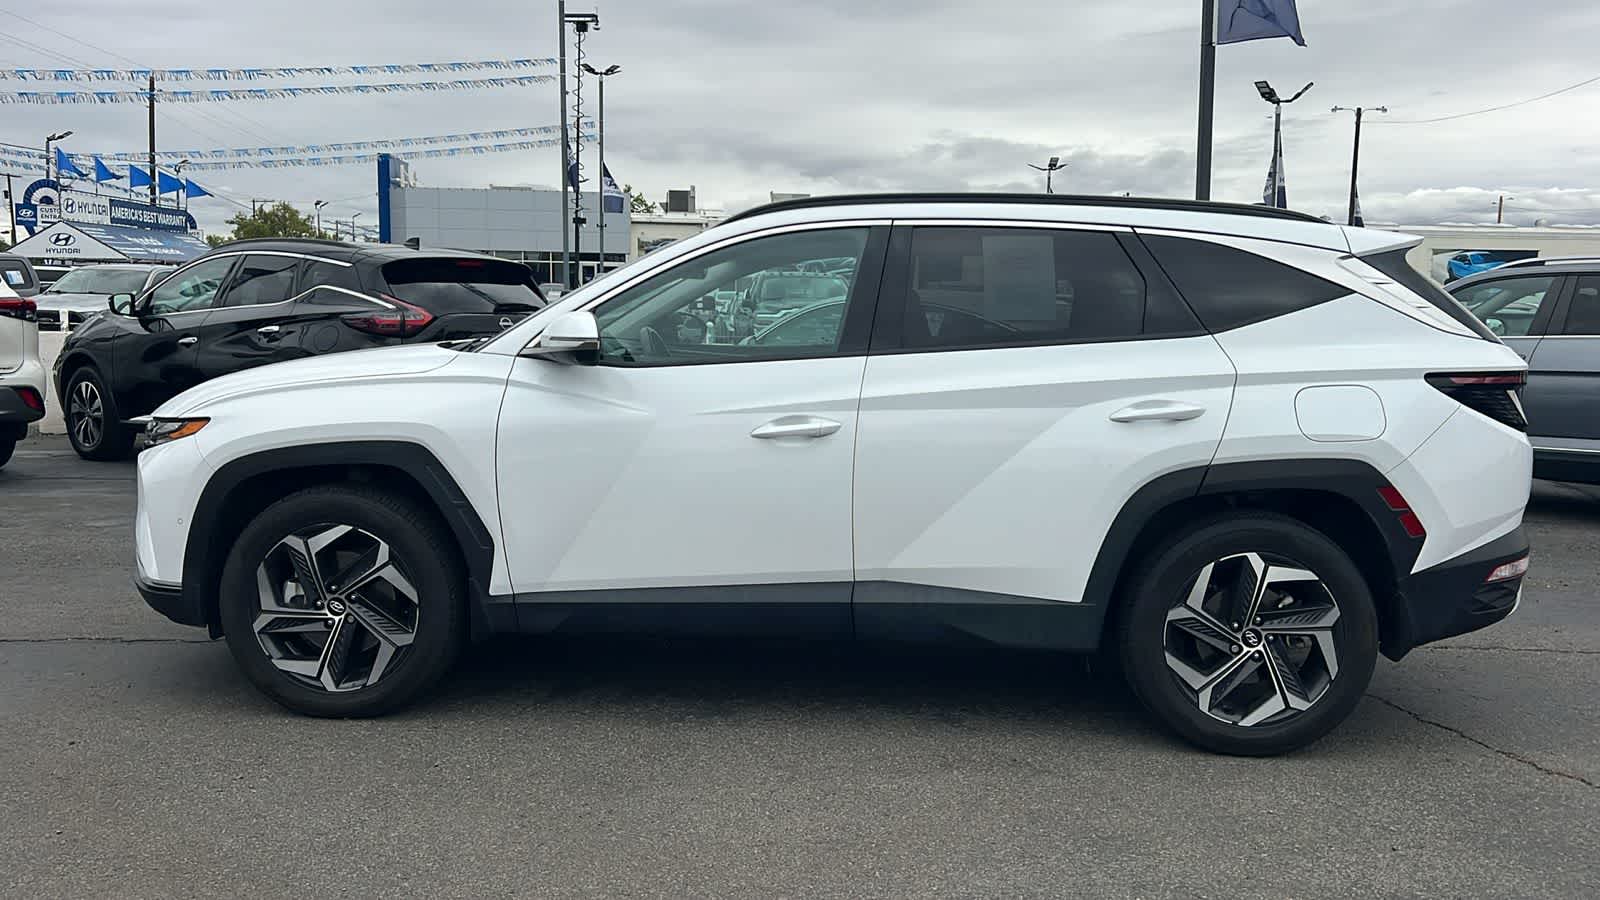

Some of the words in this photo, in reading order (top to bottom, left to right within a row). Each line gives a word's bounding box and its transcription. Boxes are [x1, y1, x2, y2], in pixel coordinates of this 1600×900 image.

[77, 201, 109, 216] HYUNDAI
[111, 206, 143, 222] AMERICA'S
[143, 210, 157, 223] BEST
[157, 212, 186, 226] WARRANTY
